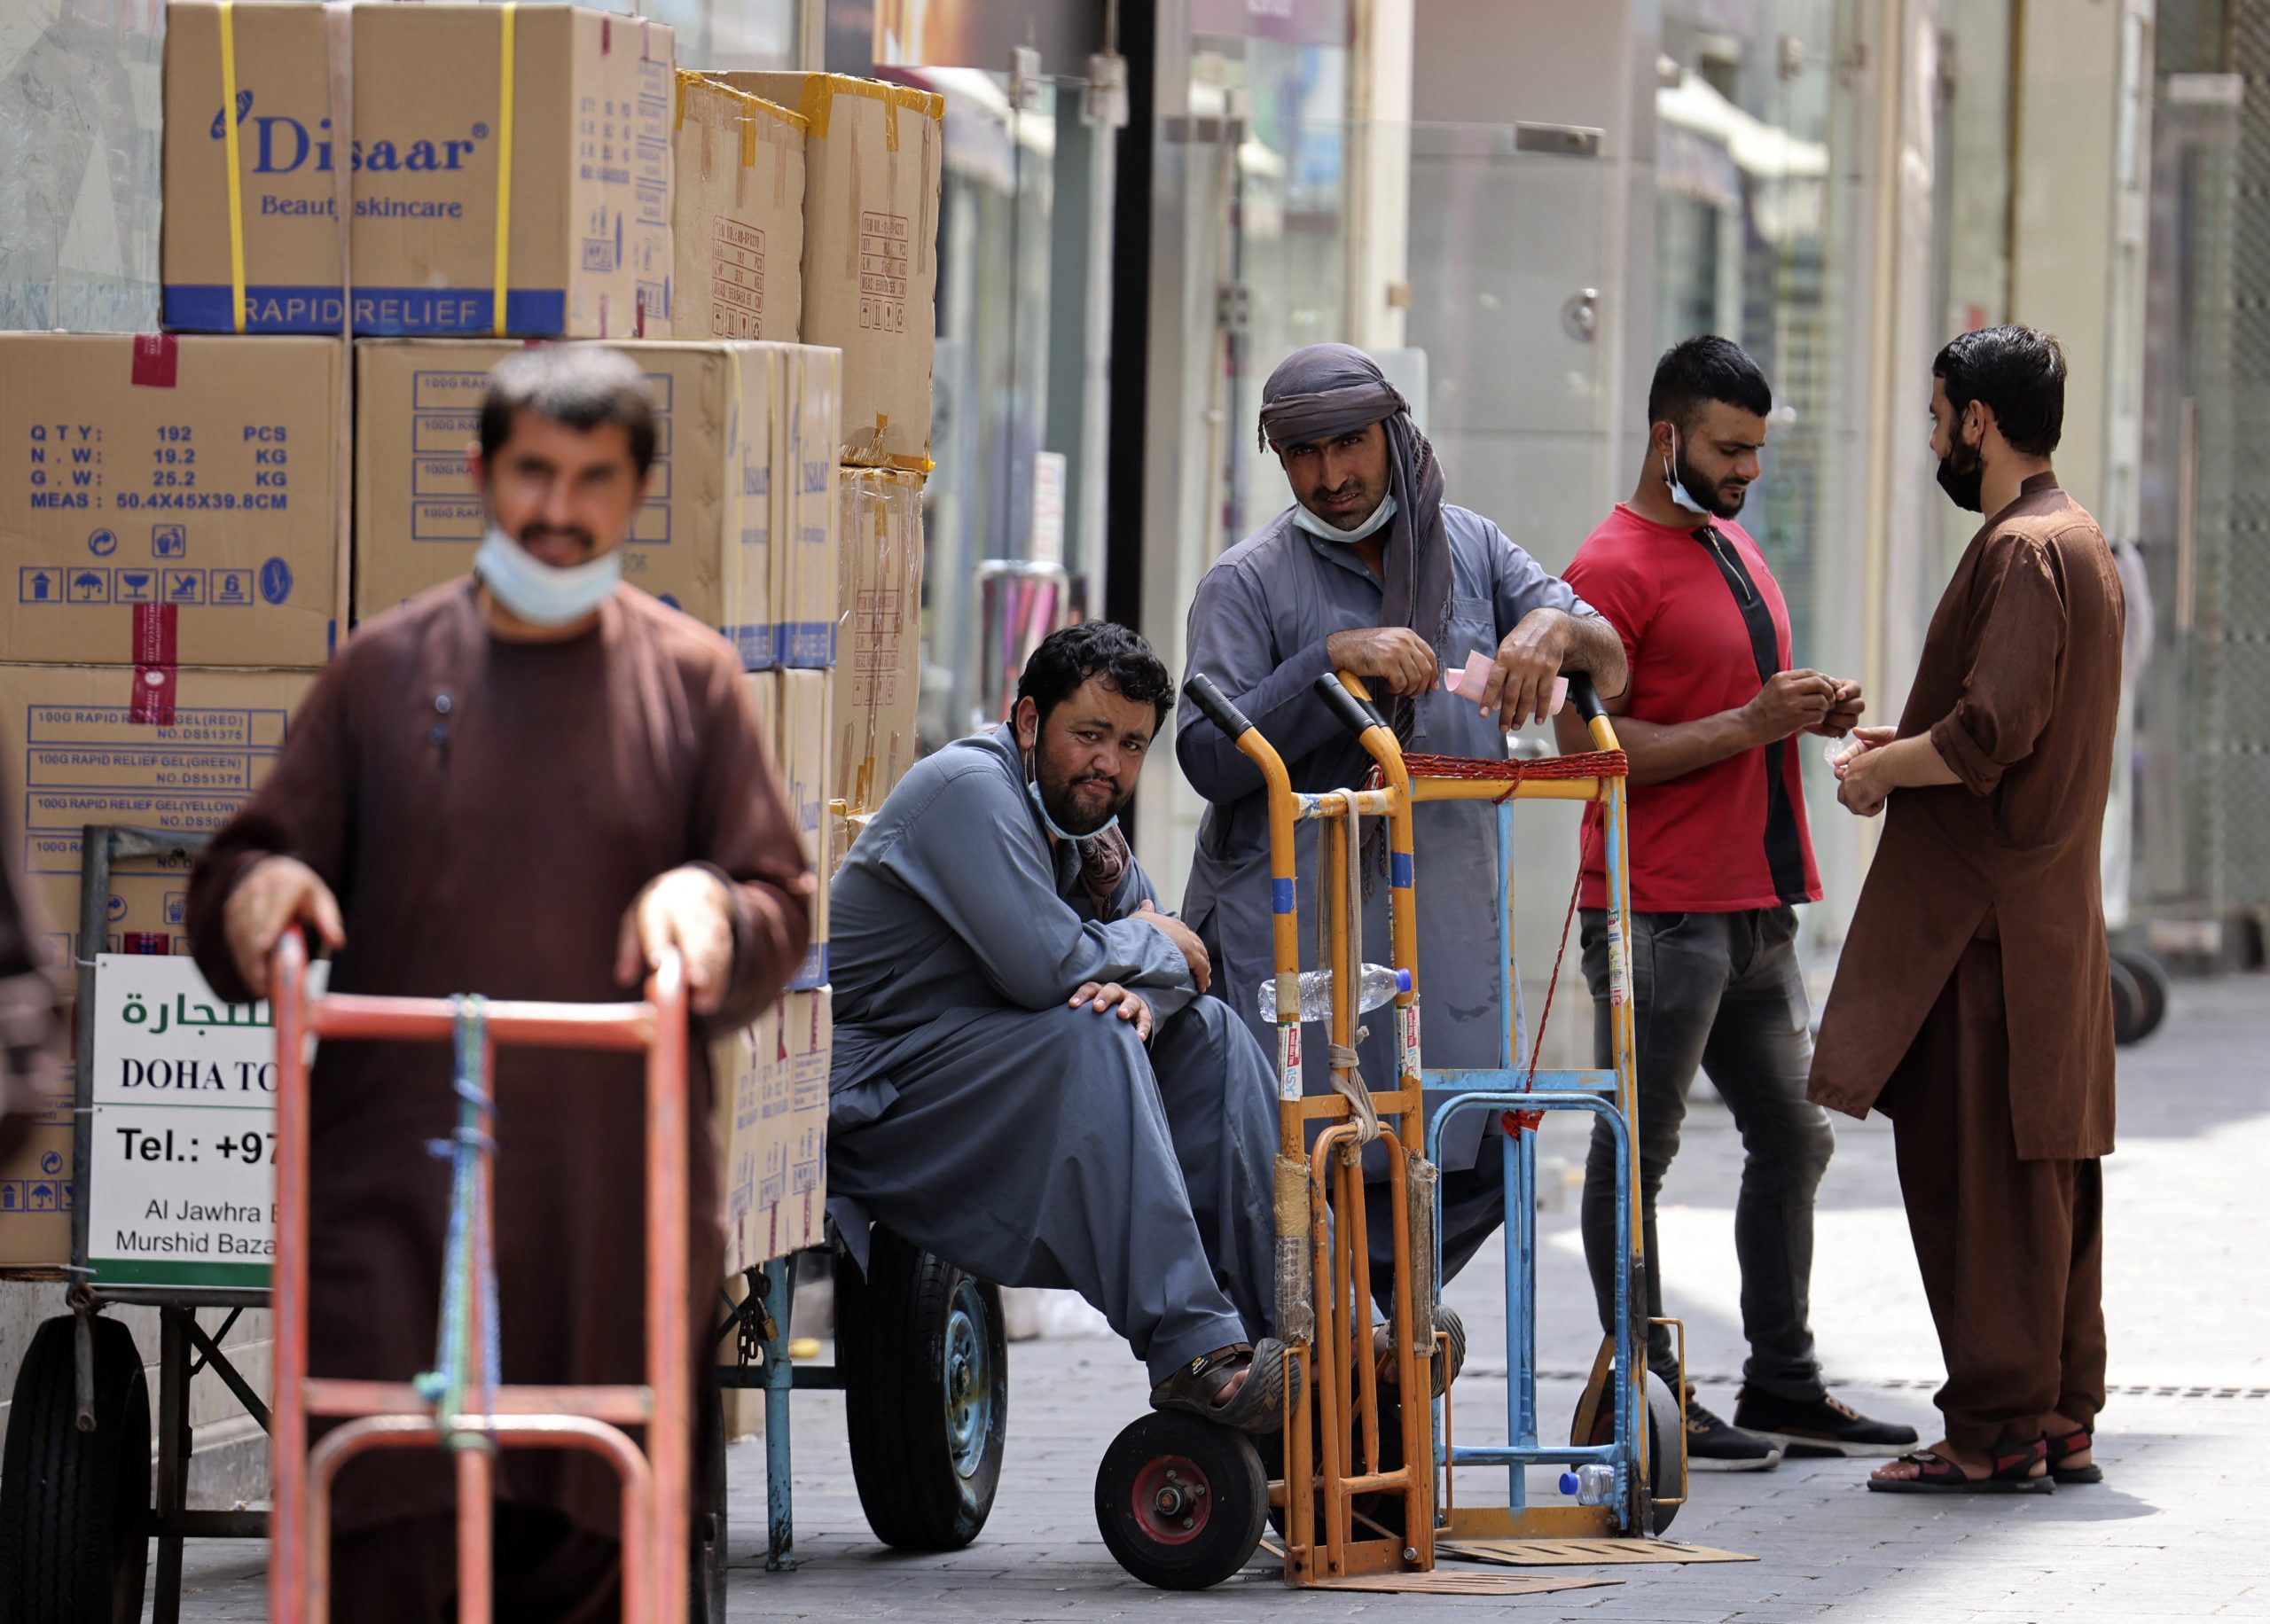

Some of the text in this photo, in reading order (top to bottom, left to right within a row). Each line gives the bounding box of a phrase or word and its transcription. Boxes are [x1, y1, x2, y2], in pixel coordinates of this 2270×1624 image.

[262, 195, 463, 222] Beaut skincare
[244, 297, 478, 325] RAPID RELIEF
[156, 426, 192, 441] 192
[243, 426, 288, 442] PCS
[153, 448, 196, 465] 19.2
[255, 448, 287, 465] KG
[153, 470, 196, 487] 25.2
[255, 470, 287, 488] KG
[116, 493, 288, 510] 50.4X45X39.8CM
[38, 712, 72, 722] 100G
[75, 712, 119, 723] RAPID
[176, 714, 244, 727] GEL(RED)
[38, 754, 242, 769] 100G RAPID RELIEF GEL(GREEN)
[38, 799, 241, 813] 100G RAPID RELIEF GEL(YELLOW)
[36, 842, 67, 852] 100G
[121, 1058, 225, 1090] DOHA
[116, 1127, 199, 1162] Tel.:
[145, 1198, 168, 1220] Al
[176, 1199, 262, 1223] Jawhra
[116, 1230, 209, 1253] Murshid
